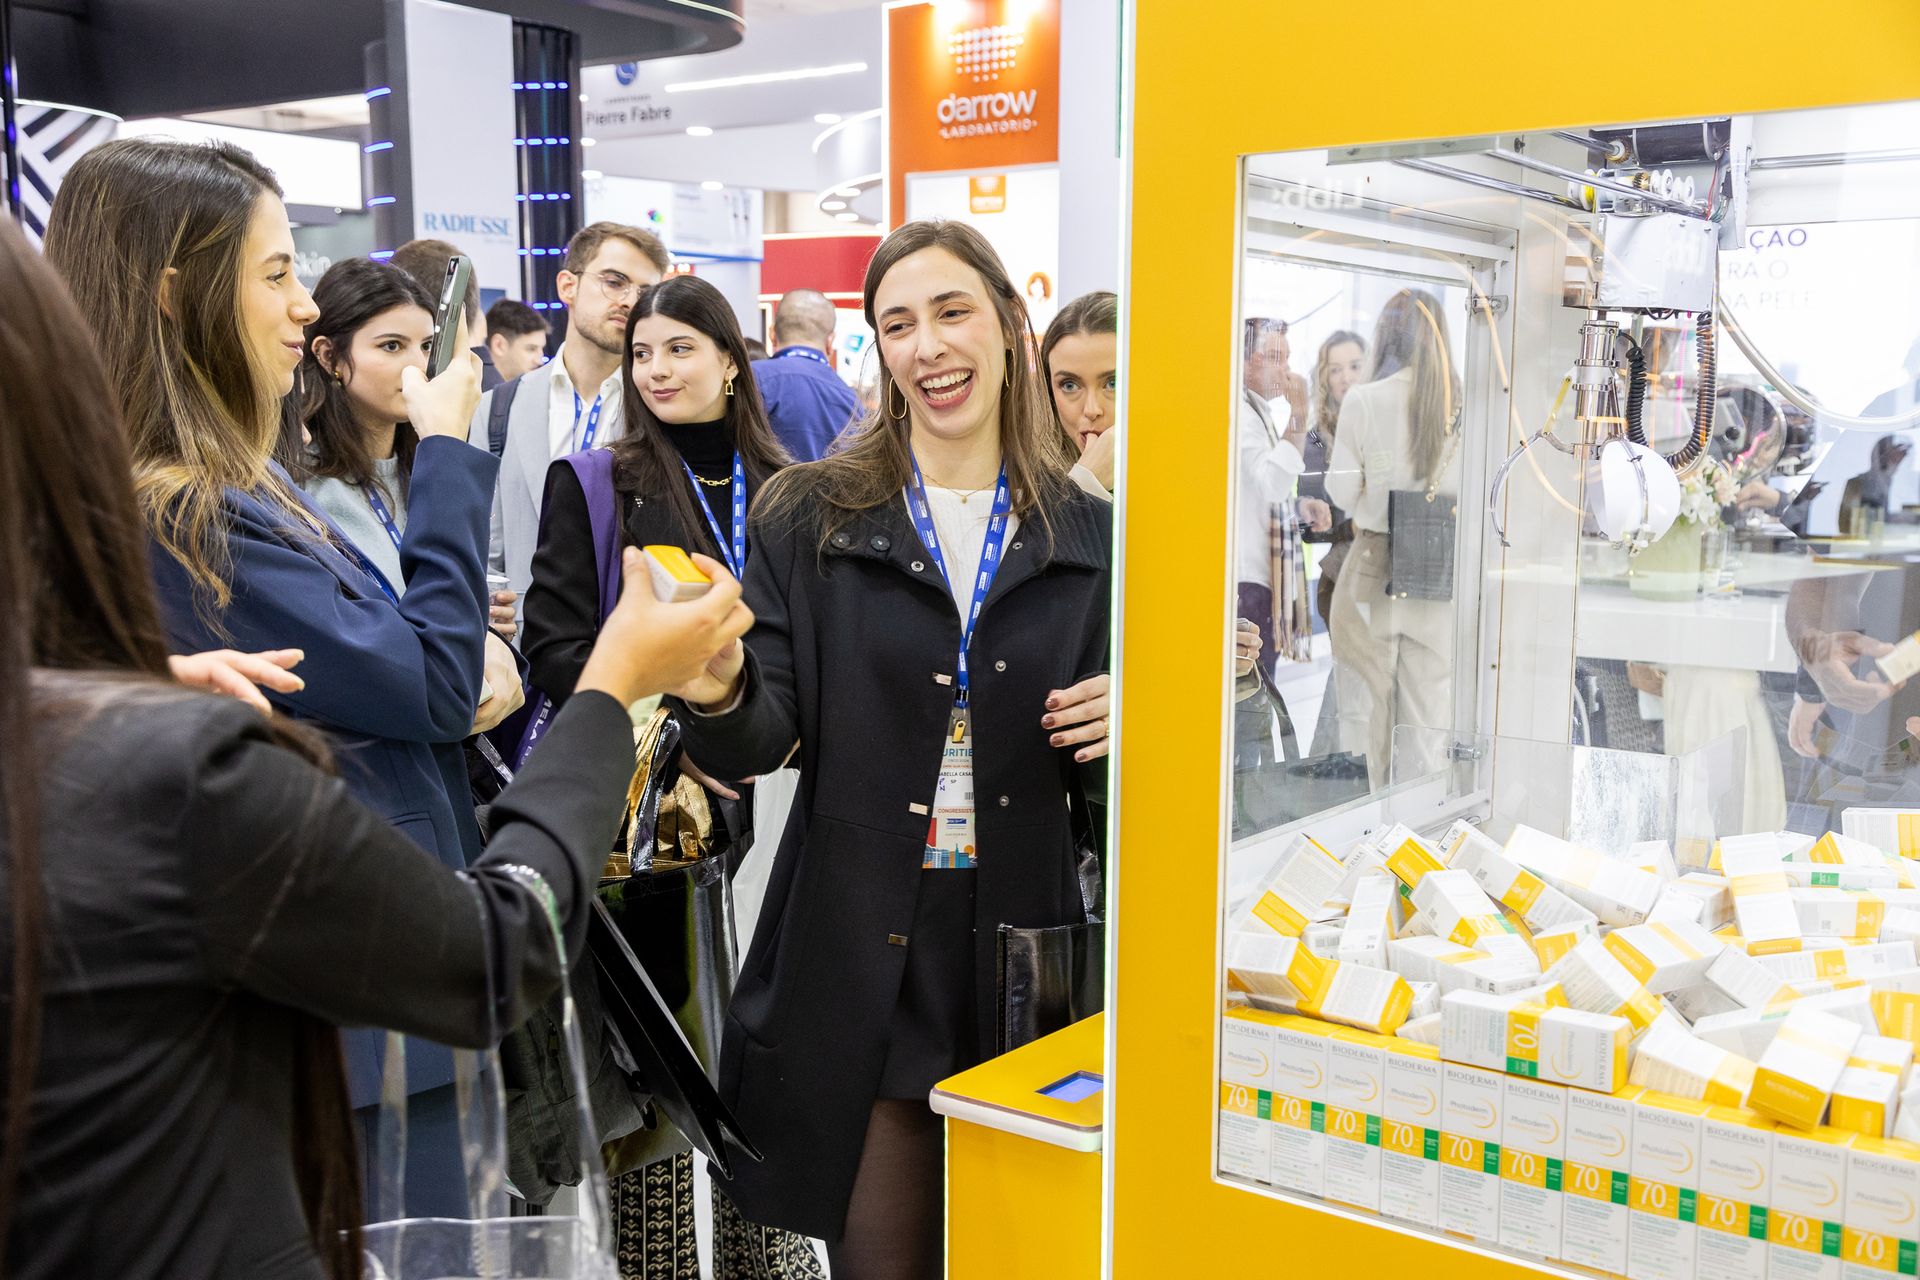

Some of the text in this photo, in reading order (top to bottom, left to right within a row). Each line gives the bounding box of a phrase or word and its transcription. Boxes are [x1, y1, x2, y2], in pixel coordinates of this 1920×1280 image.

[586, 105, 672, 125] Pierre Fabre
[937, 89, 1037, 124] darrow
[424, 212, 512, 236] RADIESSE
[1768, 259, 1789, 280] O
[1226, 1023, 1270, 1038] BIODERMA
[1513, 1023, 1538, 1049] 70
[1278, 1034, 1323, 1049] BIODERMA
[1332, 1045, 1379, 1060] BIODERMA
[1388, 1058, 1437, 1074] BIODERMA
[1447, 1070, 1497, 1086] BIODERMA
[1225, 1083, 1248, 1108] 70
[1508, 1084, 1560, 1100] BIODERMA
[1277, 1095, 1301, 1120] 70
[1450, 1100, 1488, 1113] Photoderm
[1572, 1096, 1626, 1113] BIODERMA
[1331, 1107, 1356, 1134] 70
[1638, 1111, 1694, 1128] BIODERMA
[1389, 1122, 1413, 1148] 70
[1576, 1128, 1617, 1140] Photoderm
[1707, 1126, 1765, 1144] BIODERMA
[1447, 1135, 1473, 1162] 70
[1778, 1141, 1838, 1160] BIODERMA
[1508, 1150, 1535, 1178] 70
[1853, 1158, 1916, 1177] BIODERMA
[1571, 1163, 1600, 1192] 70
[1636, 1179, 1666, 1208] 70
[1706, 1197, 1736, 1226] 70
[1777, 1212, 1808, 1243] 70
[1850, 1230, 1885, 1261] 70
